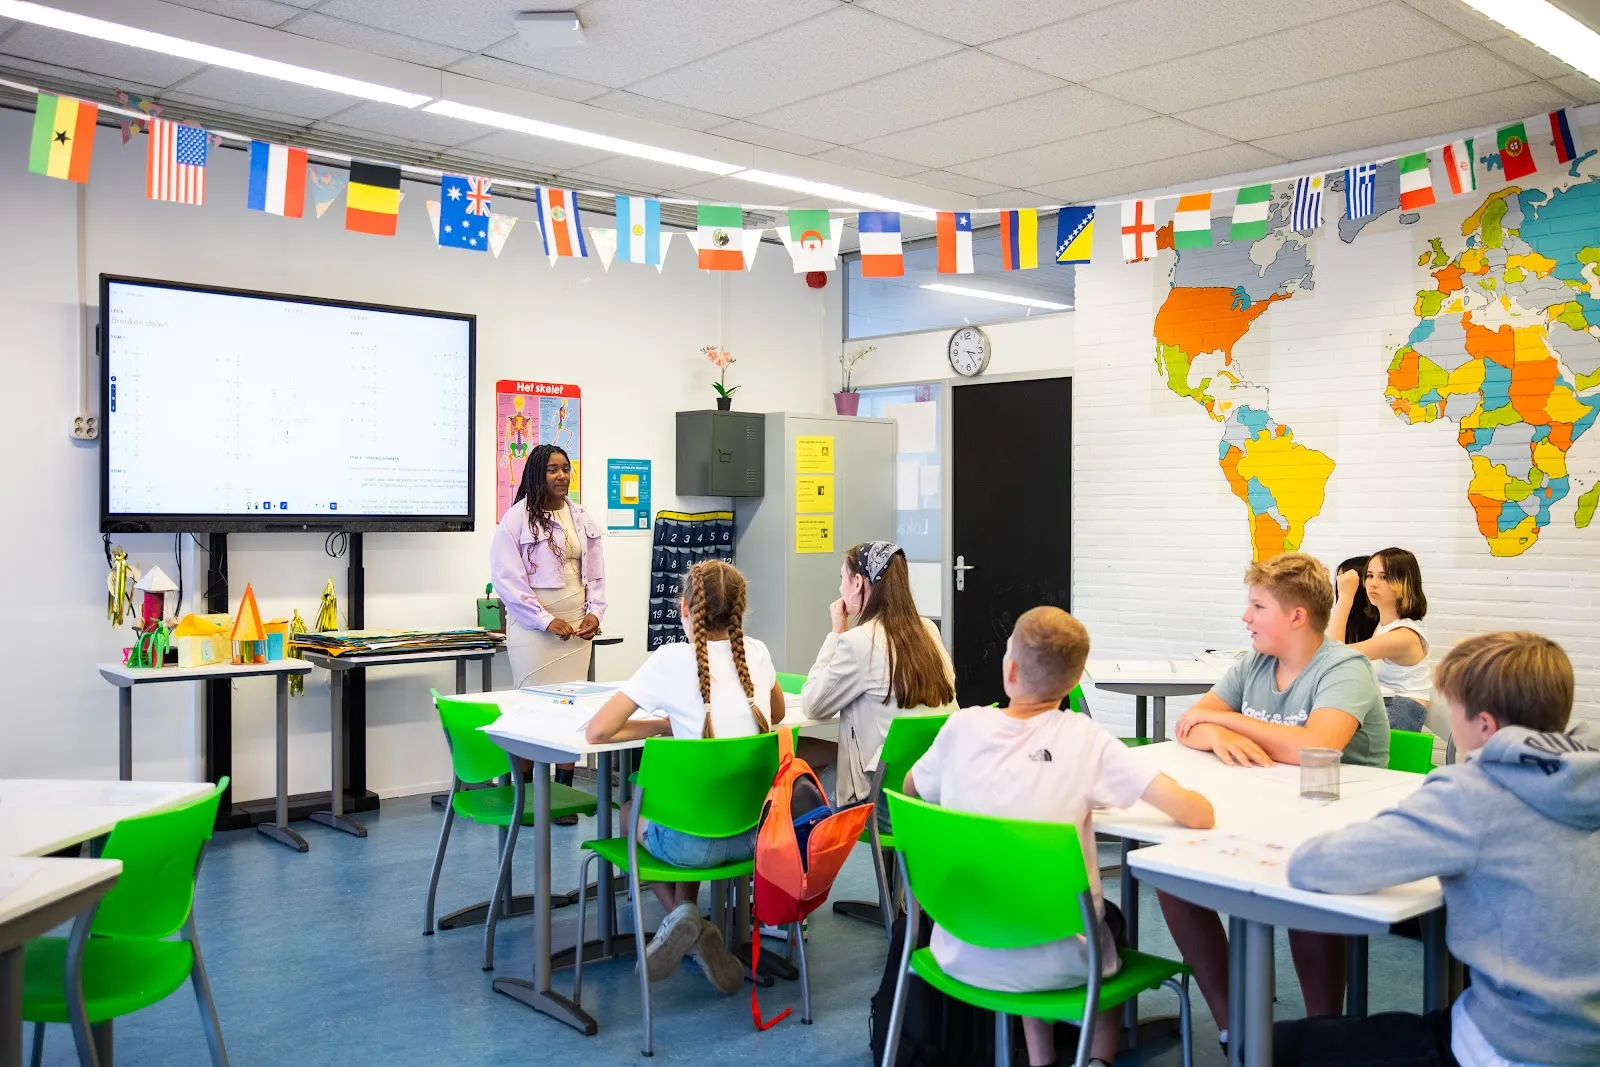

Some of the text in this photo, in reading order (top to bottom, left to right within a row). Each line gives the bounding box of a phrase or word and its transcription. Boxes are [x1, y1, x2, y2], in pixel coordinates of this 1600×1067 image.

[112, 316, 143, 326] Breuken
[964, 332, 971, 340] 12
[516, 382, 564, 394] Het skelet
[661, 532, 729, 543] 1 2 3 4 5 6
[672, 560, 677, 568] 8
[687, 560, 692, 569] 9
[656, 584, 678, 594] 13 14
[653, 609, 677, 619] 19 20
[653, 636, 663, 645] 25
[666, 635, 676, 643] 26
